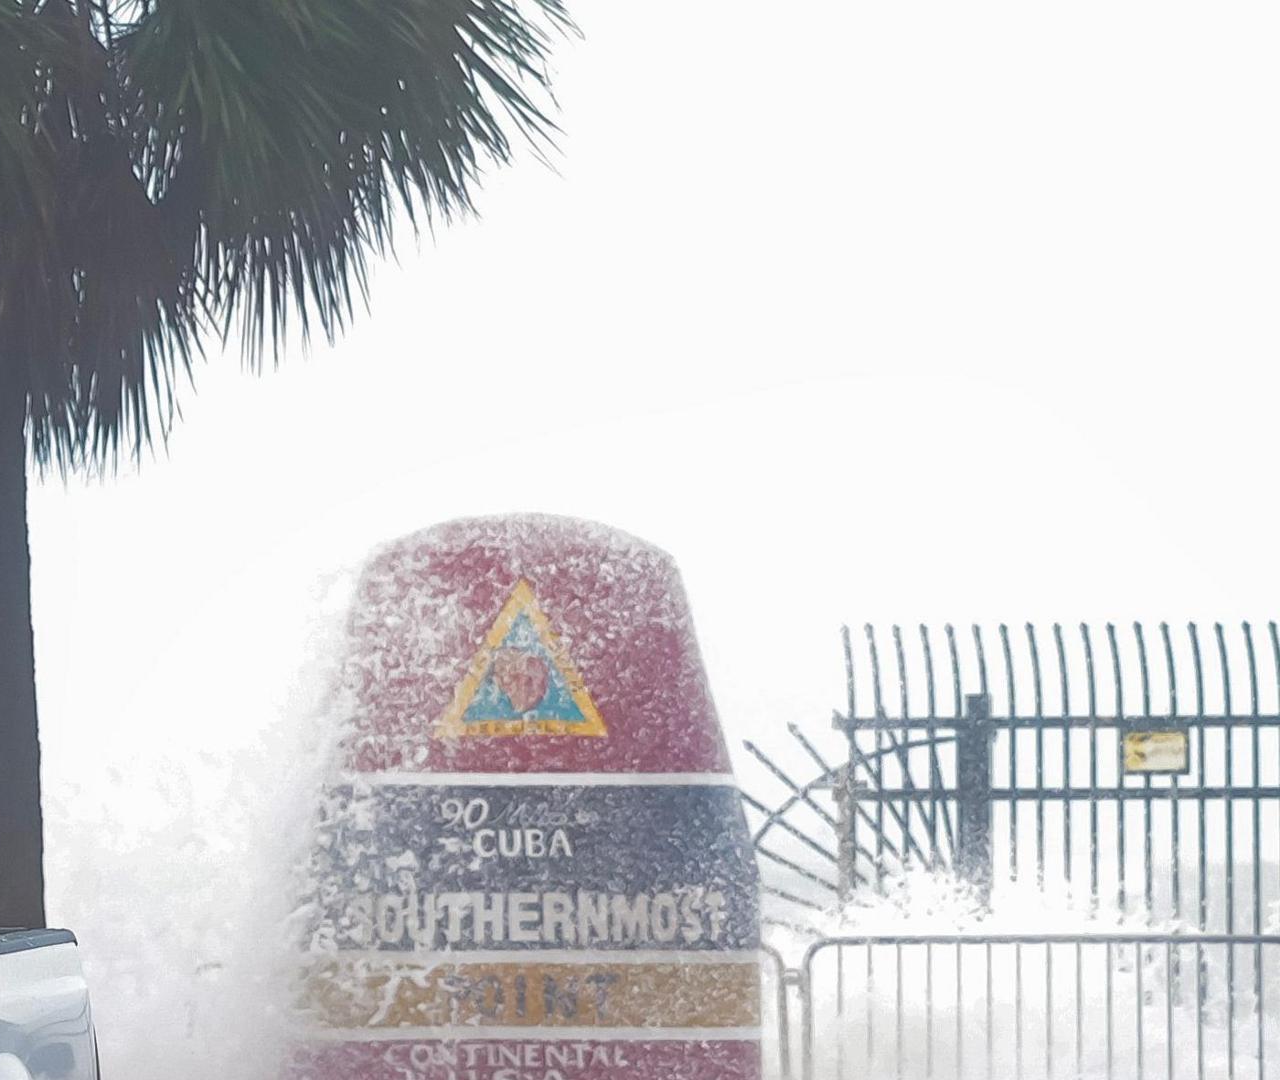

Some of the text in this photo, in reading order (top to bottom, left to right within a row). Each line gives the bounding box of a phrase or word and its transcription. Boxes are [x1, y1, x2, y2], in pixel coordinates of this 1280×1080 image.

[441, 798, 489, 830] 90
[473, 828, 573, 858] CUBA
[348, 891, 729, 945] SOUTHERNMOST
[384, 1043, 630, 1069] CONTINENTAL
